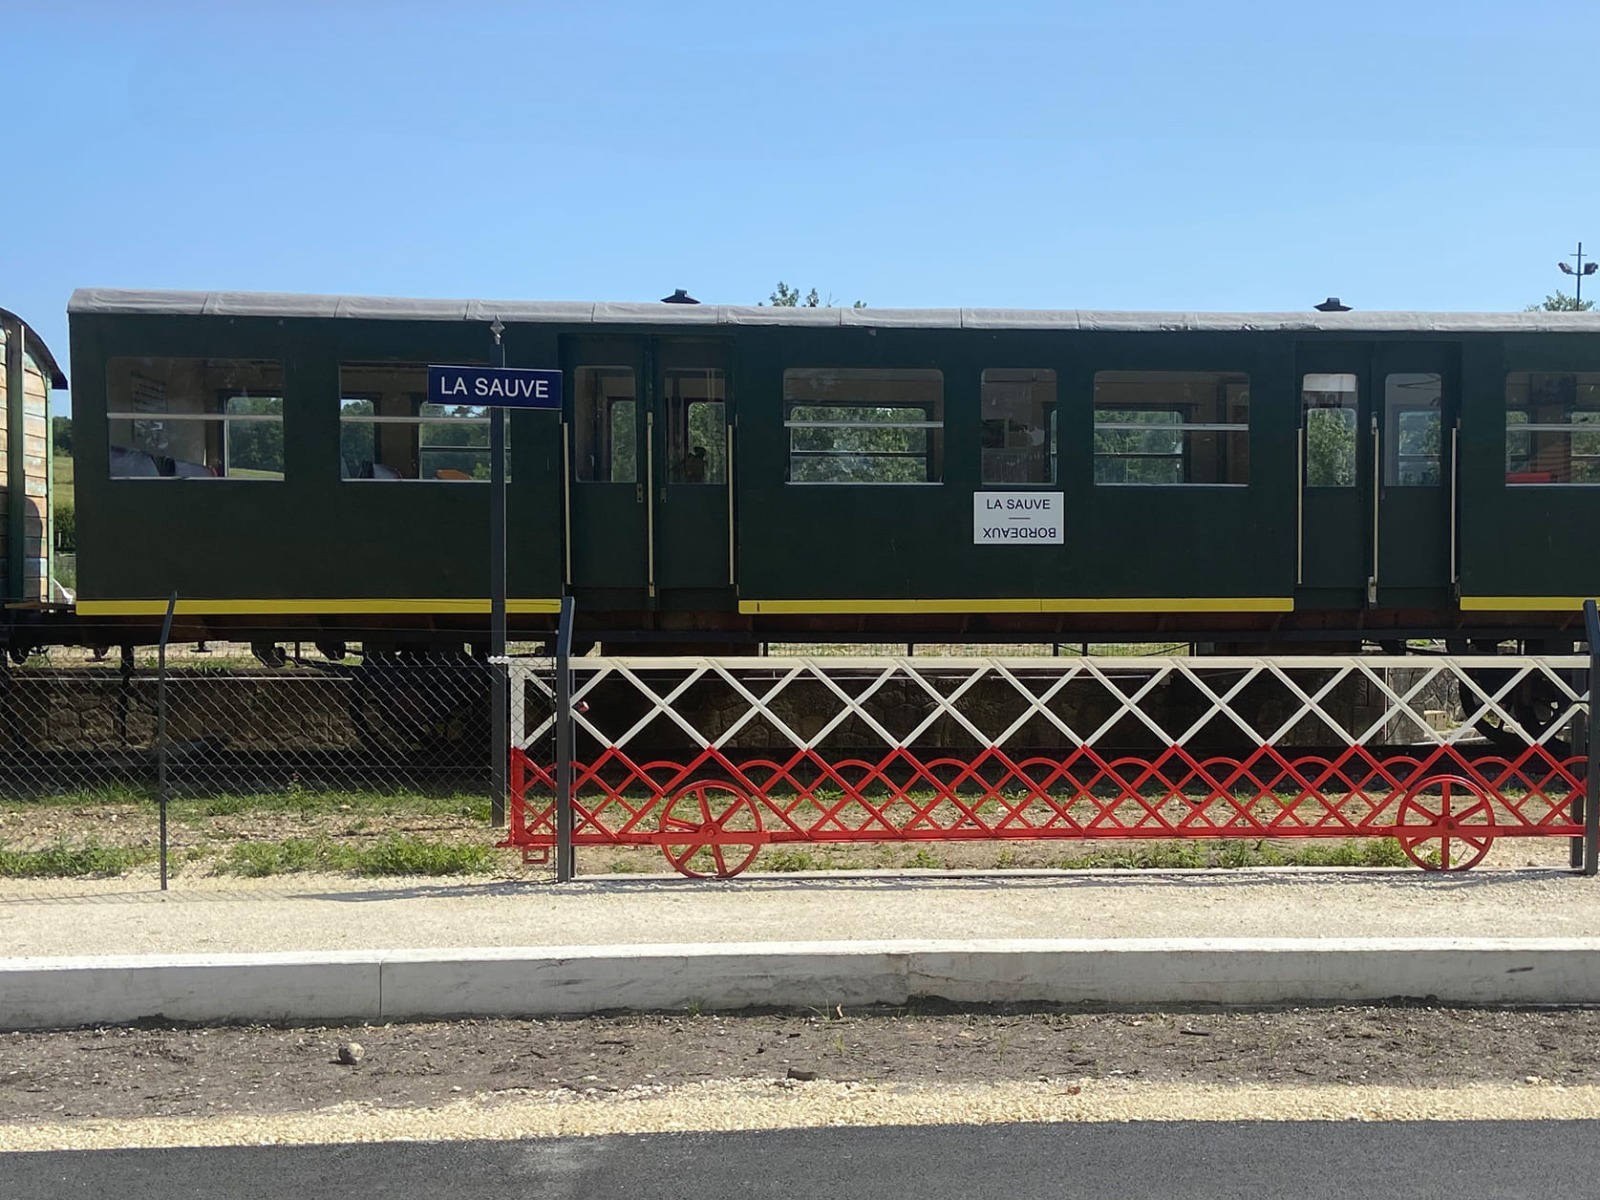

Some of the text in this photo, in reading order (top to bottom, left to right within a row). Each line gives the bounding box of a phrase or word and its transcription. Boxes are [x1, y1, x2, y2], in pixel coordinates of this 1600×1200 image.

[441, 376, 549, 398] LA SAUVE
[986, 499, 1051, 510] LA SAUVE
[982, 527, 1057, 539] BORDEAUX
